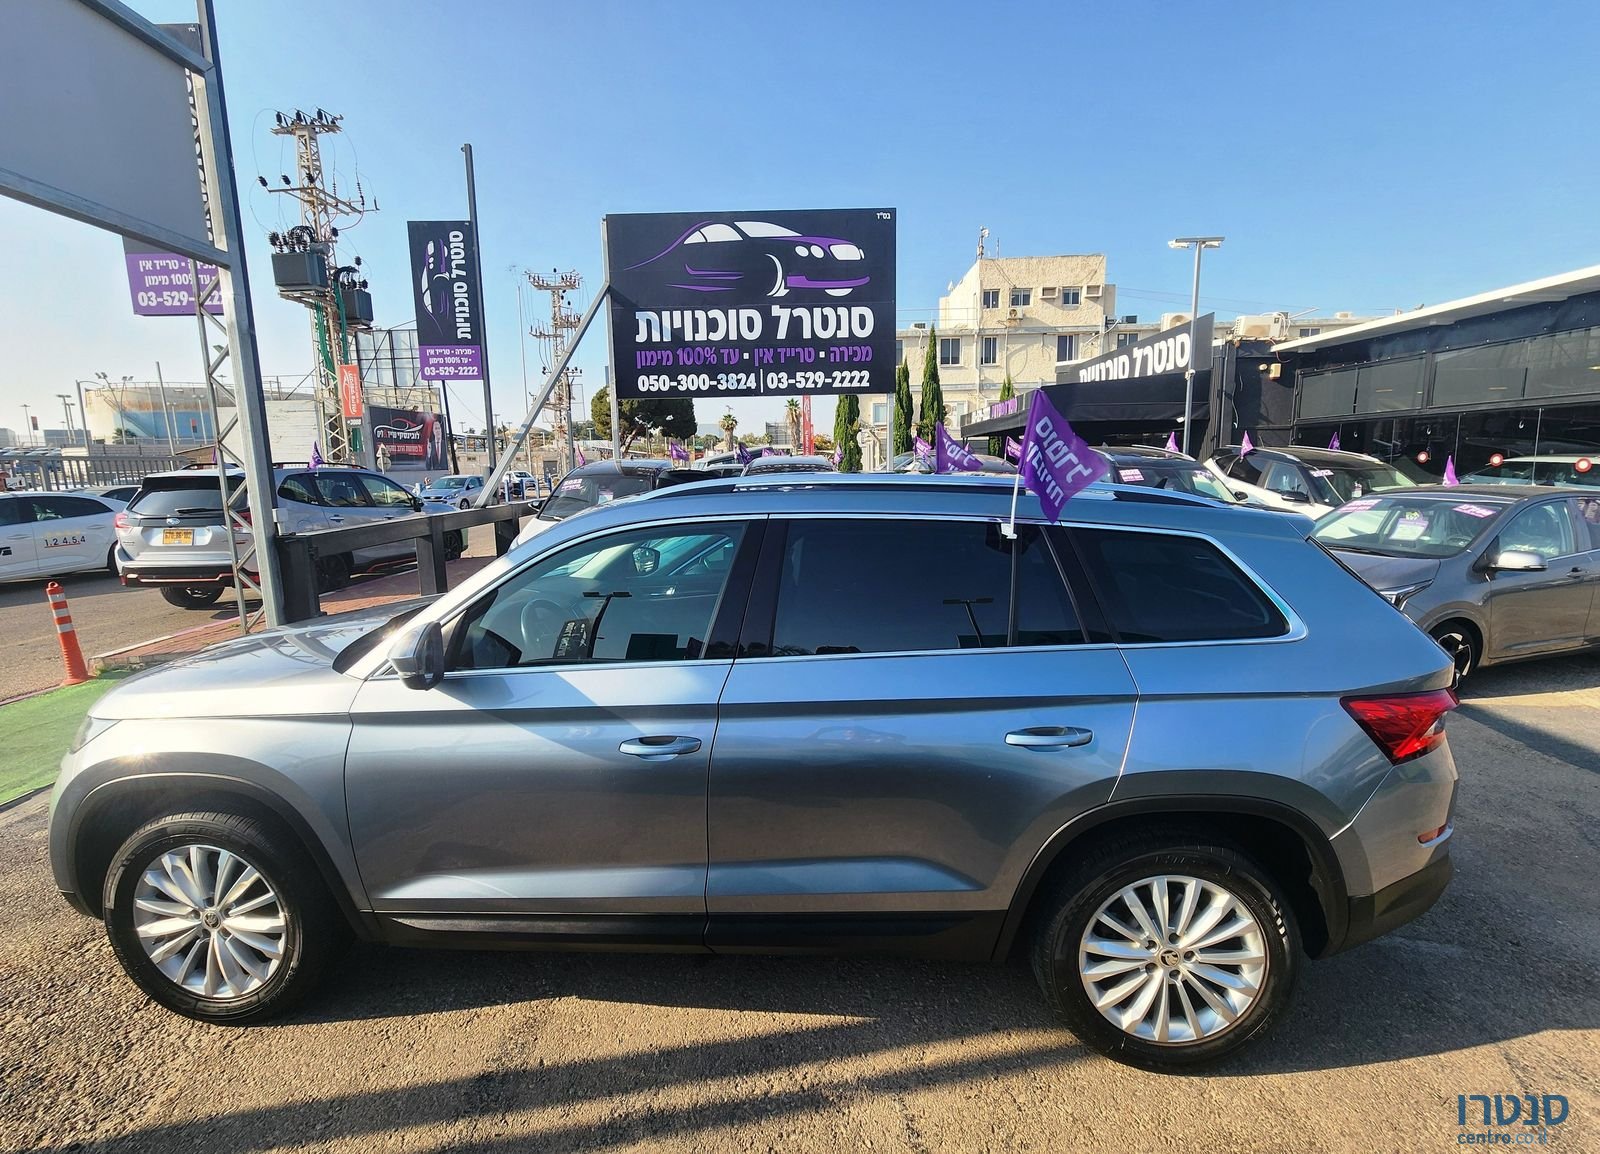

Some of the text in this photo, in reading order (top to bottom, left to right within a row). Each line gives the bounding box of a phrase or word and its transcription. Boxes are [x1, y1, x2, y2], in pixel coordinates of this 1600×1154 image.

[139, 260, 152, 273] אין
[153, 260, 179, 271] טרייד
[144, 275, 169, 288] מימון
[198, 274, 210, 285] עד
[449, 230, 472, 340] סנטרל סוכנויות
[635, 304, 875, 343] סנטרל סוכנויות
[636, 345, 873, 369] מכירה טרייד אין עד 100% מימון
[1132, 333, 1191, 378] סנטרל
[424, 366, 478, 376] 03-529-2222
[637, 370, 870, 392] 050-300-3824 03-529-2222
